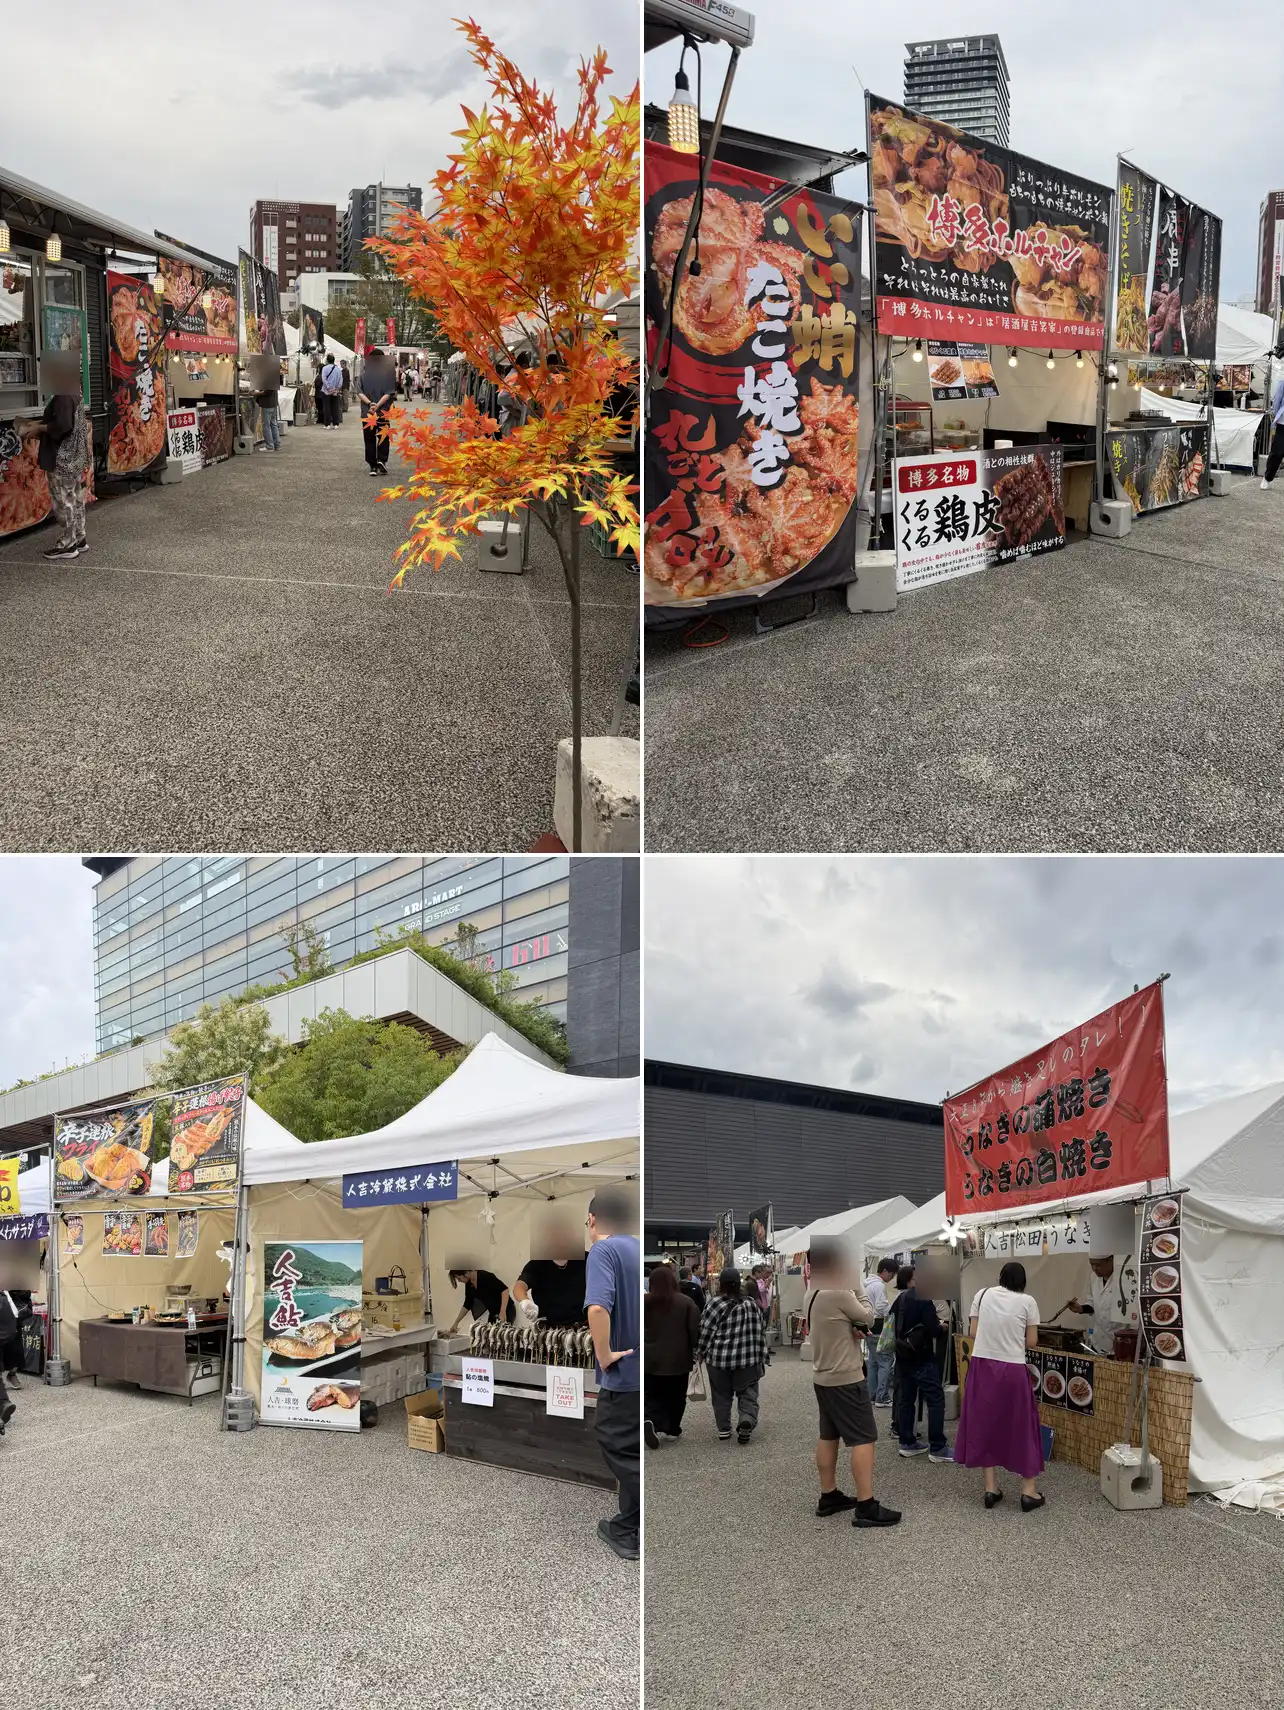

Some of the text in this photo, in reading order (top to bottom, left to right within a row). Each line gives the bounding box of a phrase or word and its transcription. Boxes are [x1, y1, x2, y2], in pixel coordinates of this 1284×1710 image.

[926, 192, 1082, 273] 博多ホルチャン
[736, 260, 802, 487] たこ焼き
[908, 464, 970, 488] 博多名物
[900, 499, 929, 525] くる
[901, 525, 931, 552] くる
[932, 489, 1005, 544] 鶏皮
[57, 1121, 115, 1146] 辛子蓮根
[960, 1066, 1112, 1157] うなぎの蒲焼き
[62, 1140, 99, 1160] フライ
[962, 1129, 1113, 1201] うなぎの白焼き
[269, 1249, 302, 1331] 人吉鮎
